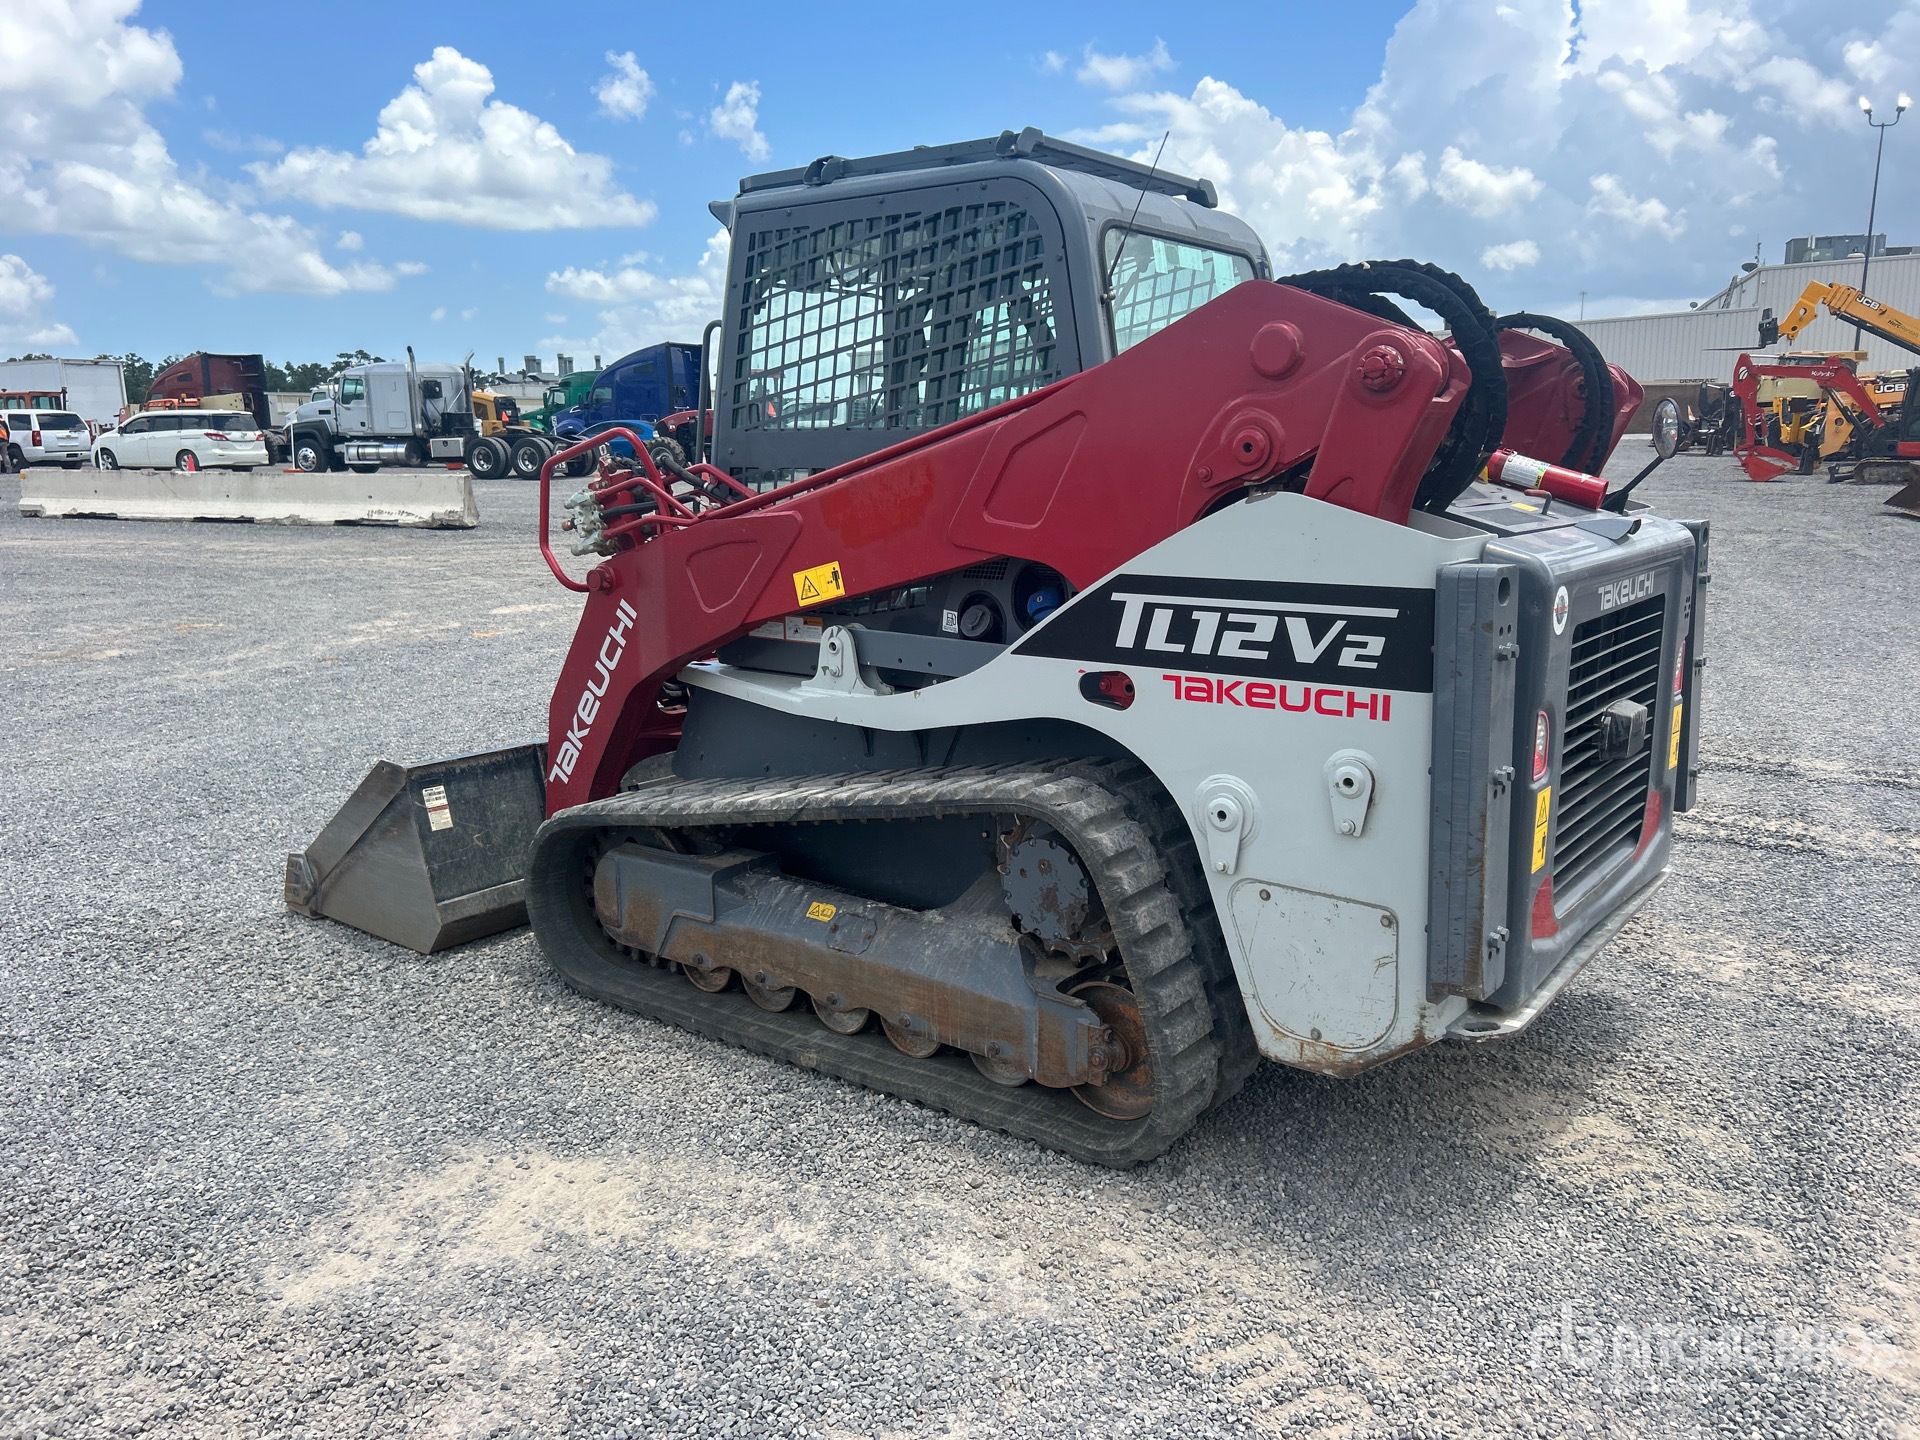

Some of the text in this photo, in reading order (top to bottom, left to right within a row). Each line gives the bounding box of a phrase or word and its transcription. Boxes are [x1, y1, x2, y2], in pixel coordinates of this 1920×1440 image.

[1856, 293, 1880, 310] JCB
[1875, 384, 1906, 394] JCB
[1598, 571, 1655, 611] TAKEUCHI
[549, 598, 638, 785] TAKEUCHI
[1162, 674, 1391, 722] TAKEUCHI
